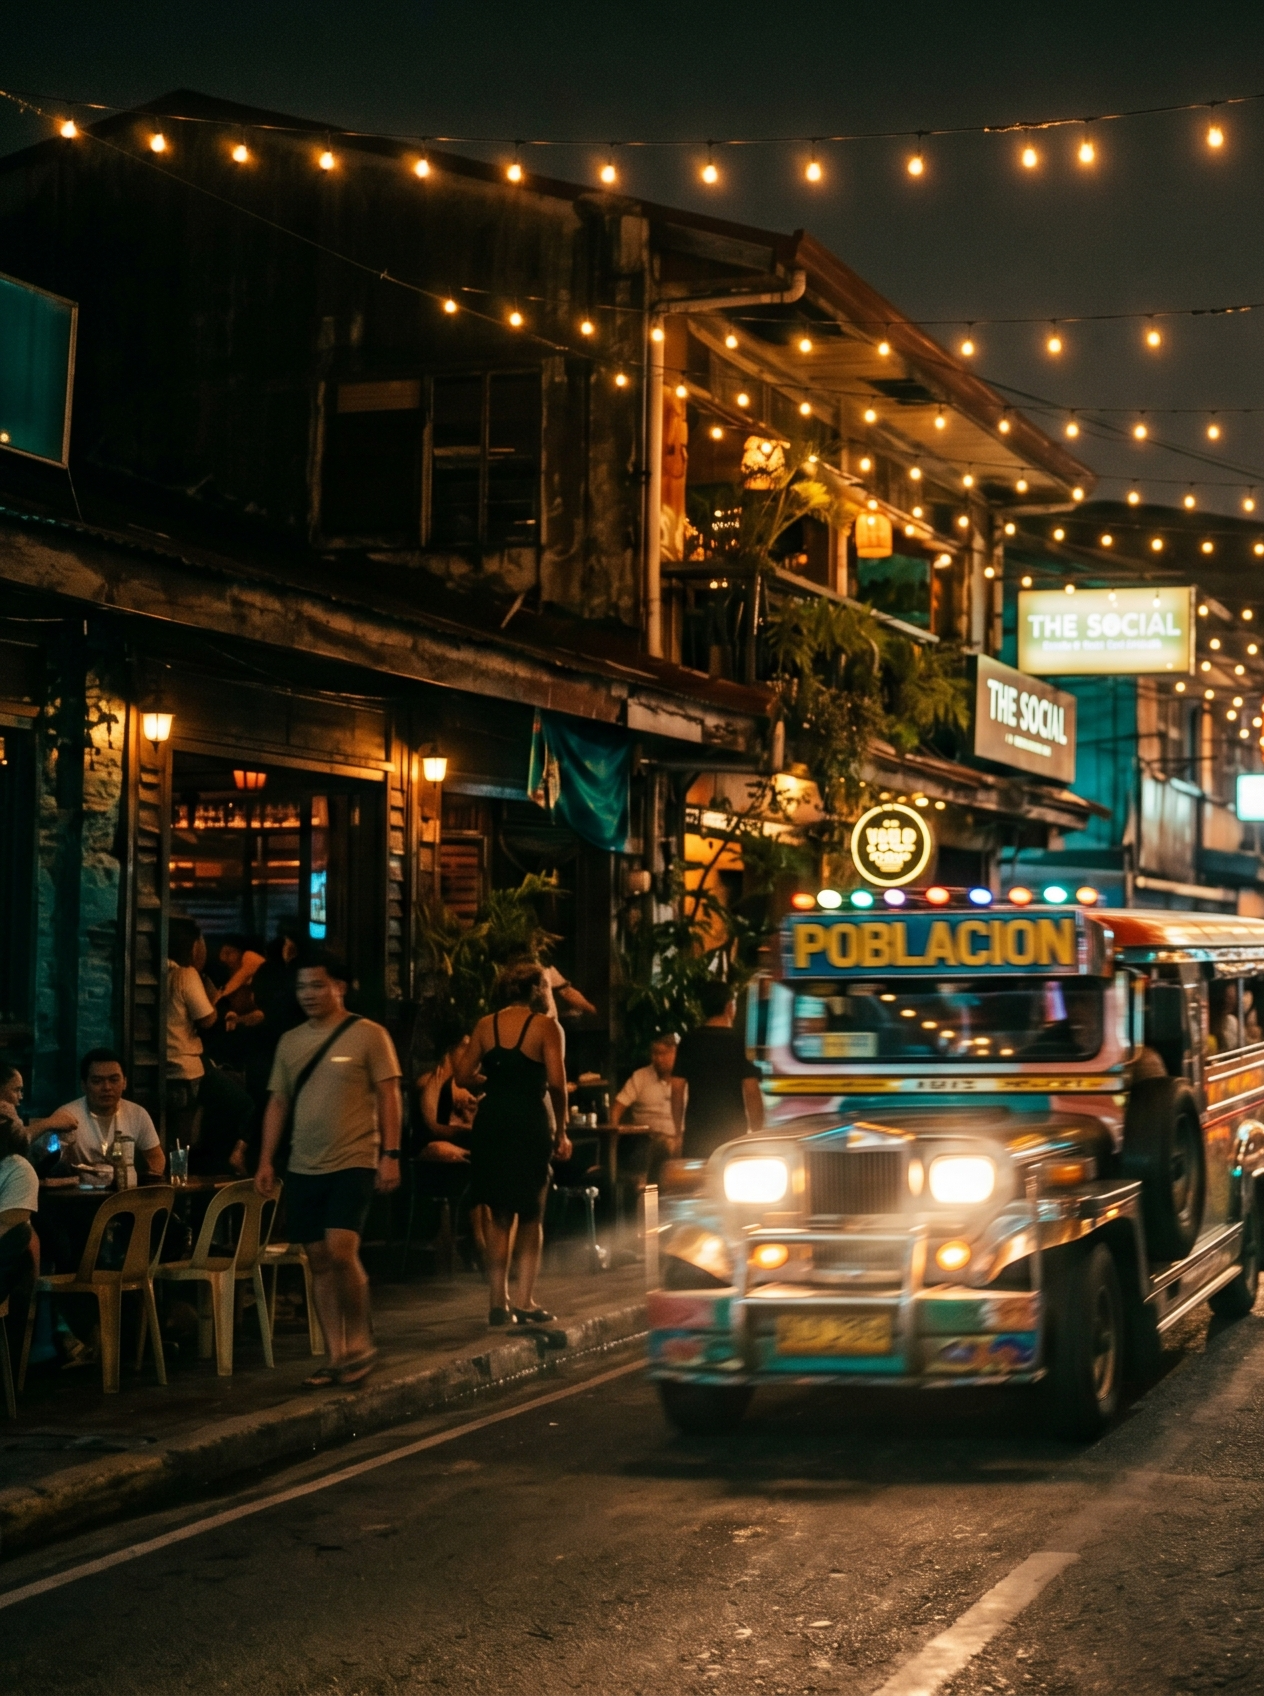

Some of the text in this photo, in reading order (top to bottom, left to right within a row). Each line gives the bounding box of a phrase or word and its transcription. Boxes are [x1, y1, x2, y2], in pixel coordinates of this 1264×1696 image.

[1027, 612, 1182, 638] THE SOCIAL
[987, 678, 1018, 728] THE
[1019, 691, 1068, 746] SOCIAL
[793, 918, 1075, 969] POBLACION
